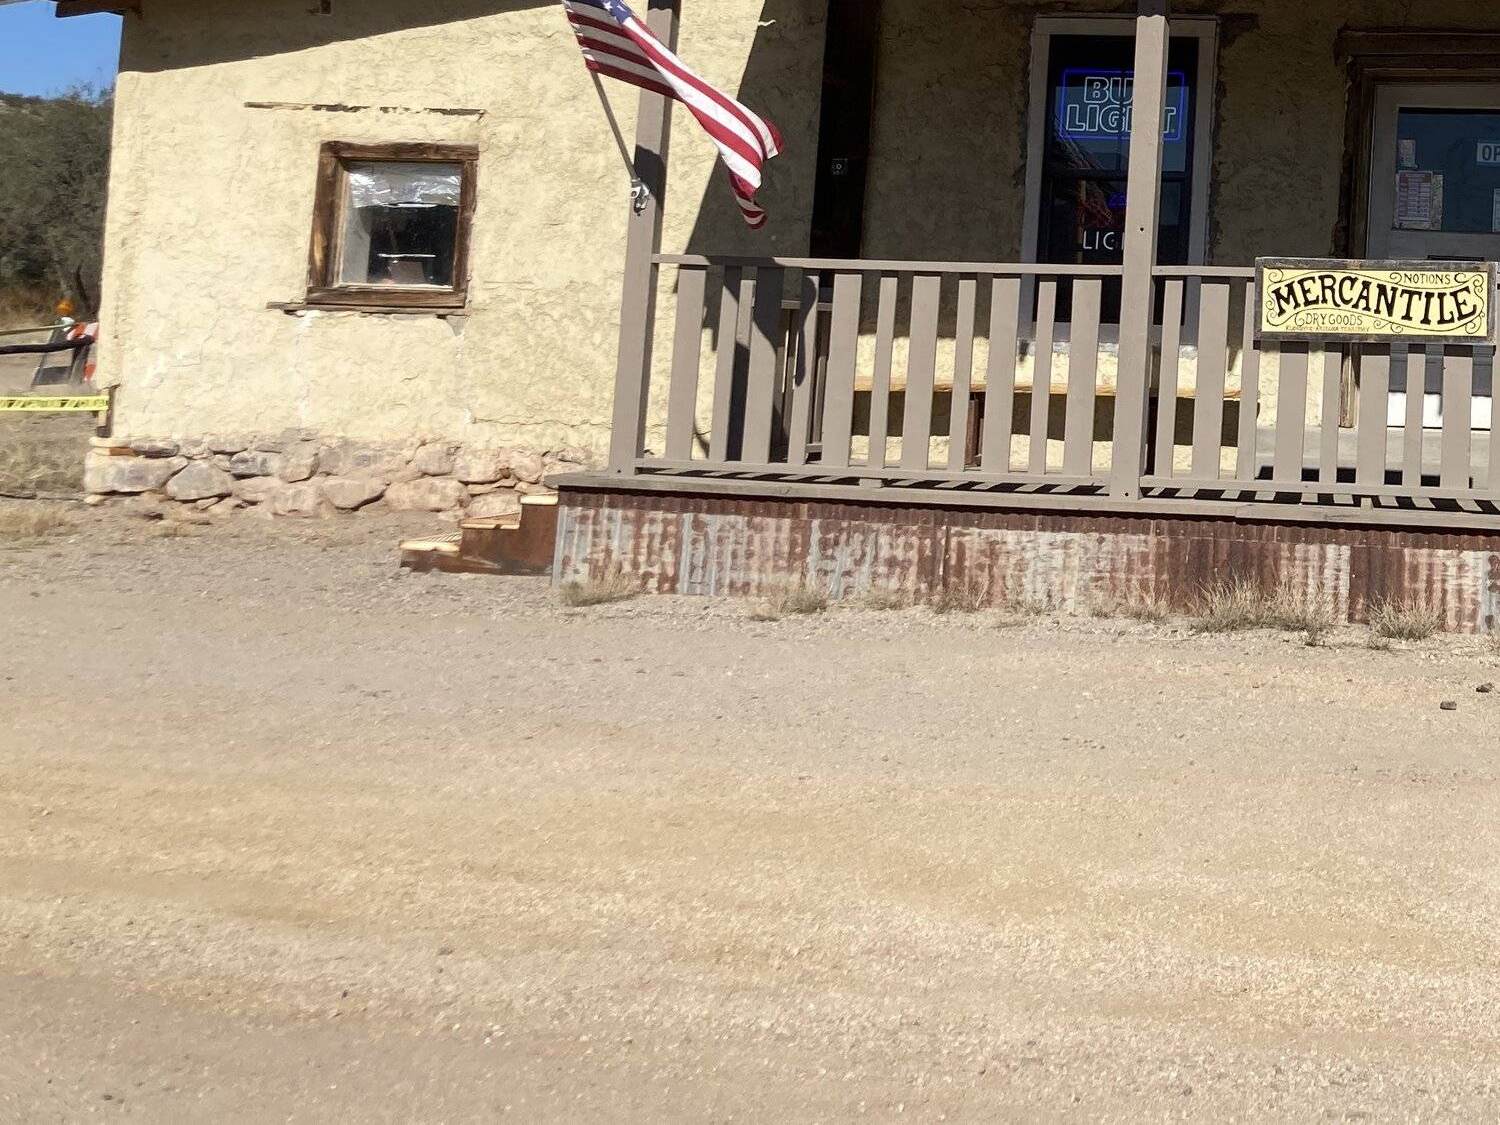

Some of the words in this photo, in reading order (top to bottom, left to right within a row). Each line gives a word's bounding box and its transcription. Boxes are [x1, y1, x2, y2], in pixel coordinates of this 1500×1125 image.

[1083, 76, 1134, 105] BU
[1066, 104, 1177, 134] LIGT
[1403, 273, 1451, 285] NOTIONS
[1271, 274, 1478, 326] MERCANTILE
[1305, 312, 1328, 327] DRY
[1328, 313, 1363, 326] GOODS
